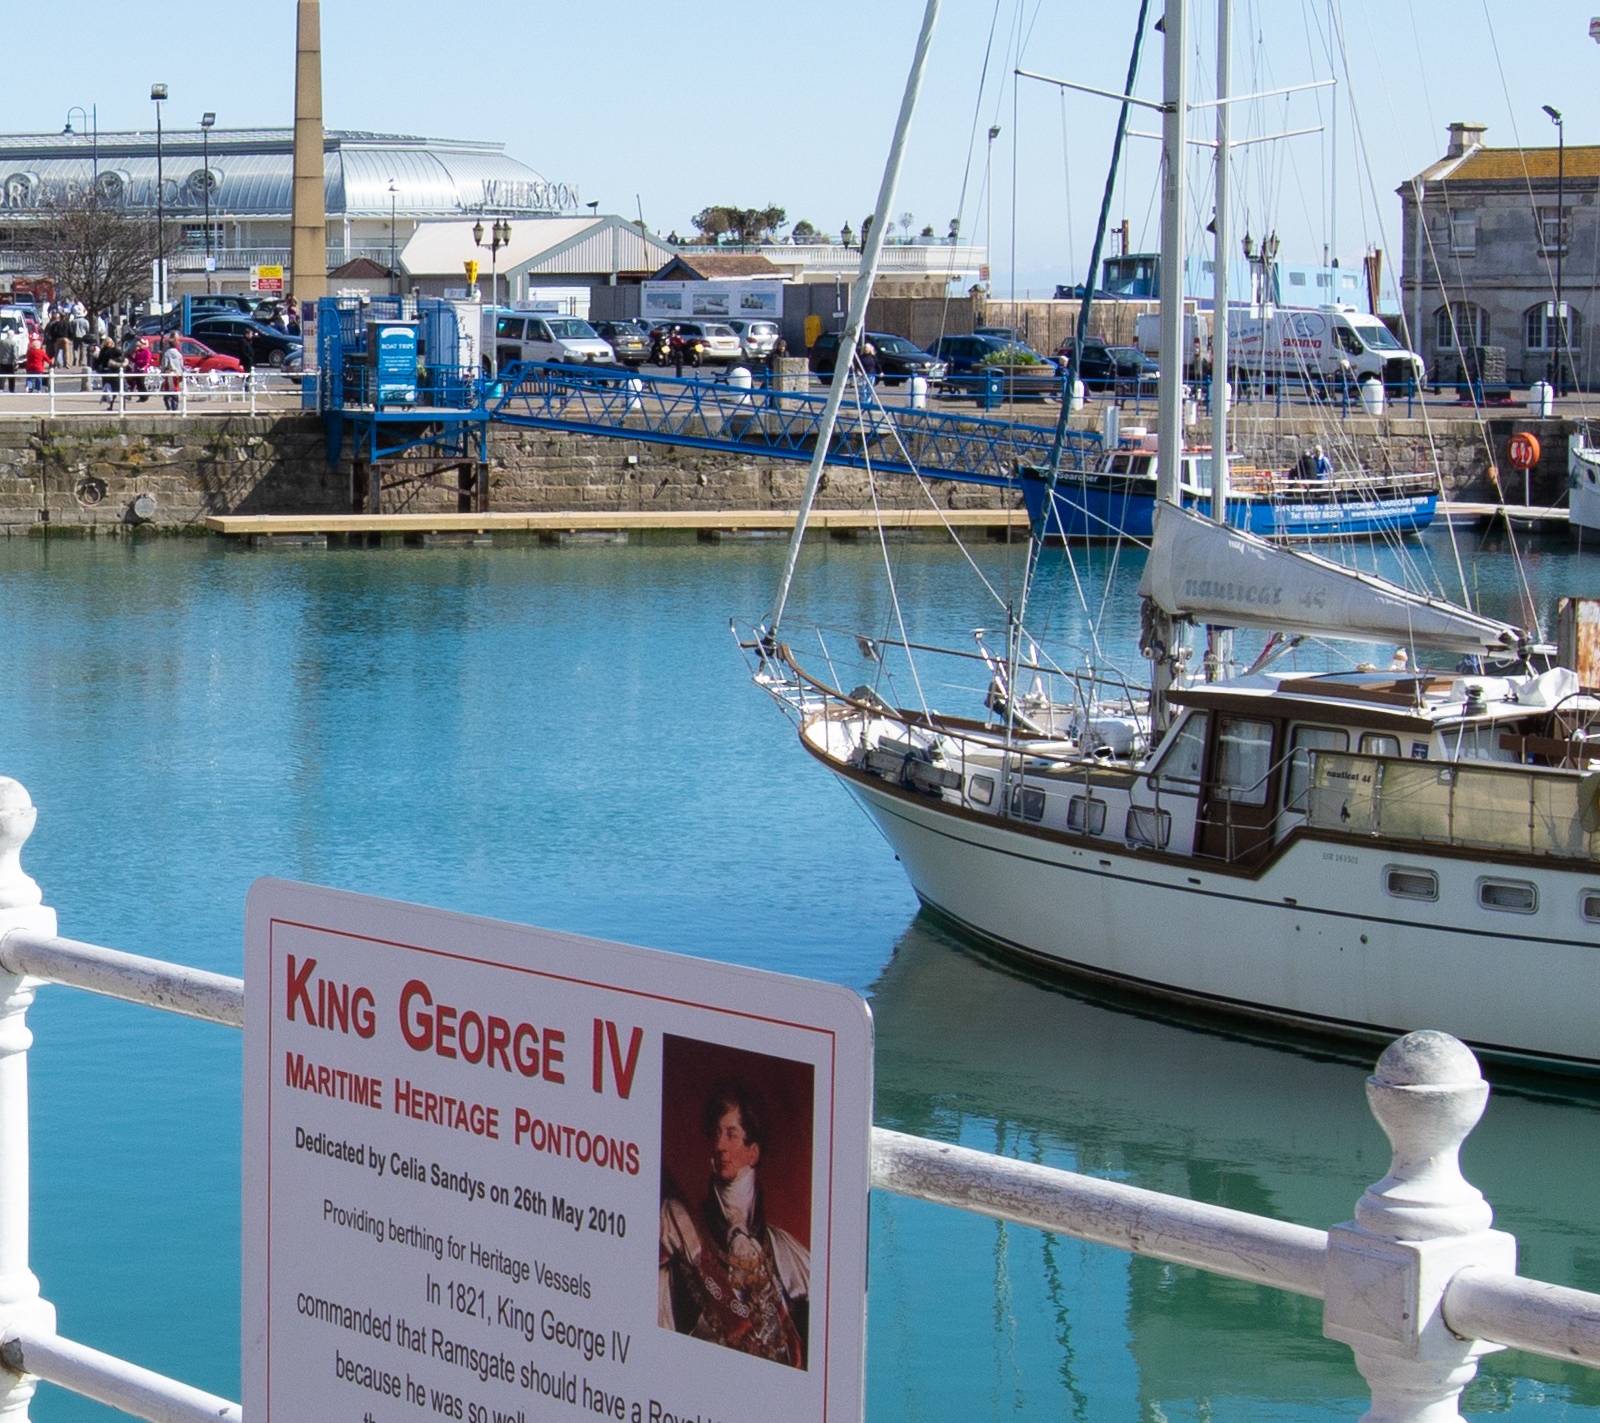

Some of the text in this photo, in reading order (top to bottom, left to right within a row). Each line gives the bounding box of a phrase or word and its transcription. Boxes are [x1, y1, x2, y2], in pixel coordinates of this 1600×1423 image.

[286, 954, 644, 1100] KING GEORGE IV
[285, 1051, 640, 1175] MARITIME HERITAGE PONTOONS
[295, 1126, 626, 1238] Dedicated by Celia Sandys on 26th May 2010
[323, 1199, 591, 1299] Providing berthing for Heritage Vessels
[297, 1292, 391, 1342] commanded
[396, 1318, 427, 1355] that
[431, 1329, 515, 1383] Ramsgate
[520, 1361, 576, 1404] should
[583, 1378, 625, 1420] have
[426, 1273, 631, 1364] In 1821, King George IV
[336, 1349, 401, 1398] because
[407, 1373, 426, 1407] he
[431, 1389, 463, 1420] was
